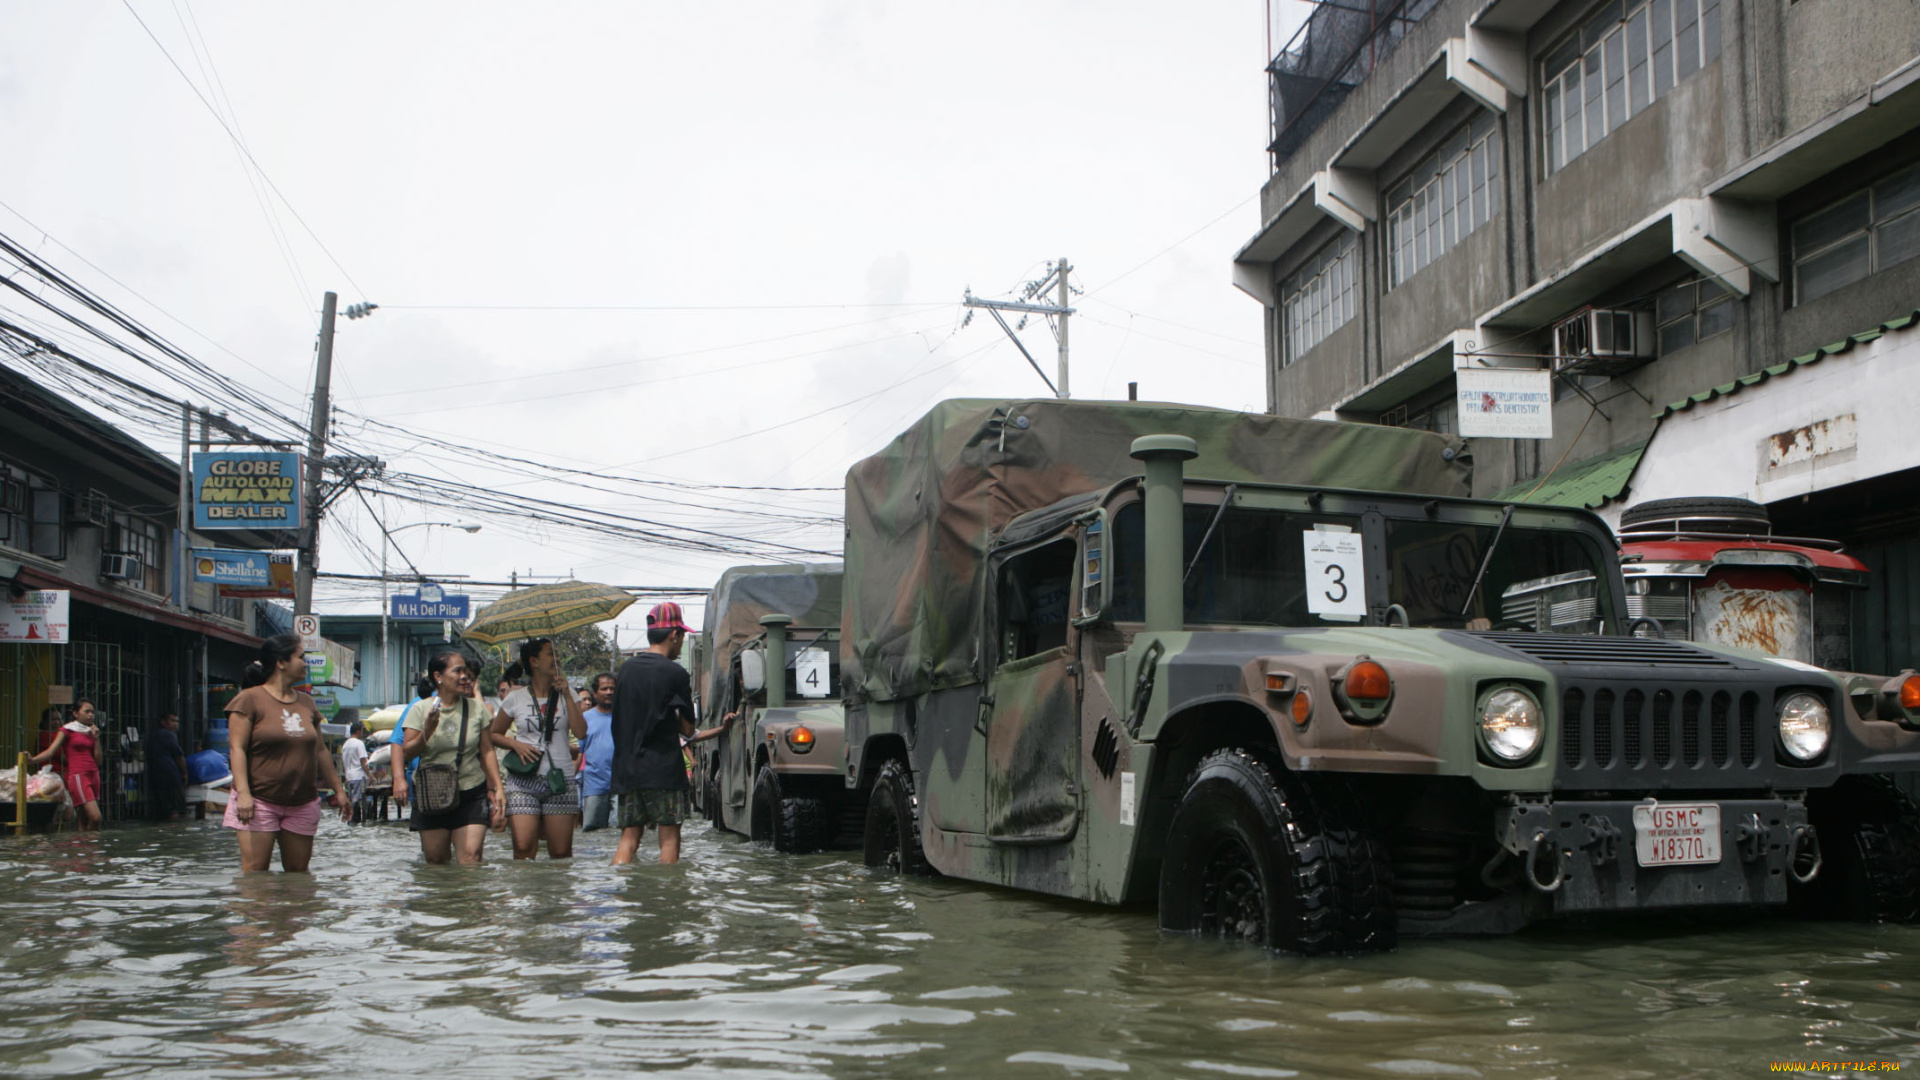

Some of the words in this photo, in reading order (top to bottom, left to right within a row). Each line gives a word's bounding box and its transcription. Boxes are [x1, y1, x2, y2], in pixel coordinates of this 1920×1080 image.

[1504, 403, 1540, 414] DENTISTRY
[210, 460, 282, 476] GLOBE
[201, 476, 295, 488] AUTOLOAD
[200, 487, 295, 504] MAX
[208, 506, 287, 519] DEALER
[216, 561, 267, 577] Shellane
[1324, 563, 1348, 603] 3
[421, 603, 437, 616] Del
[439, 604, 461, 616] Pilar
[805, 668, 820, 688] 4
[1652, 810, 1698, 828] USMC
[1658, 829, 1680, 837] OFFICIAL
